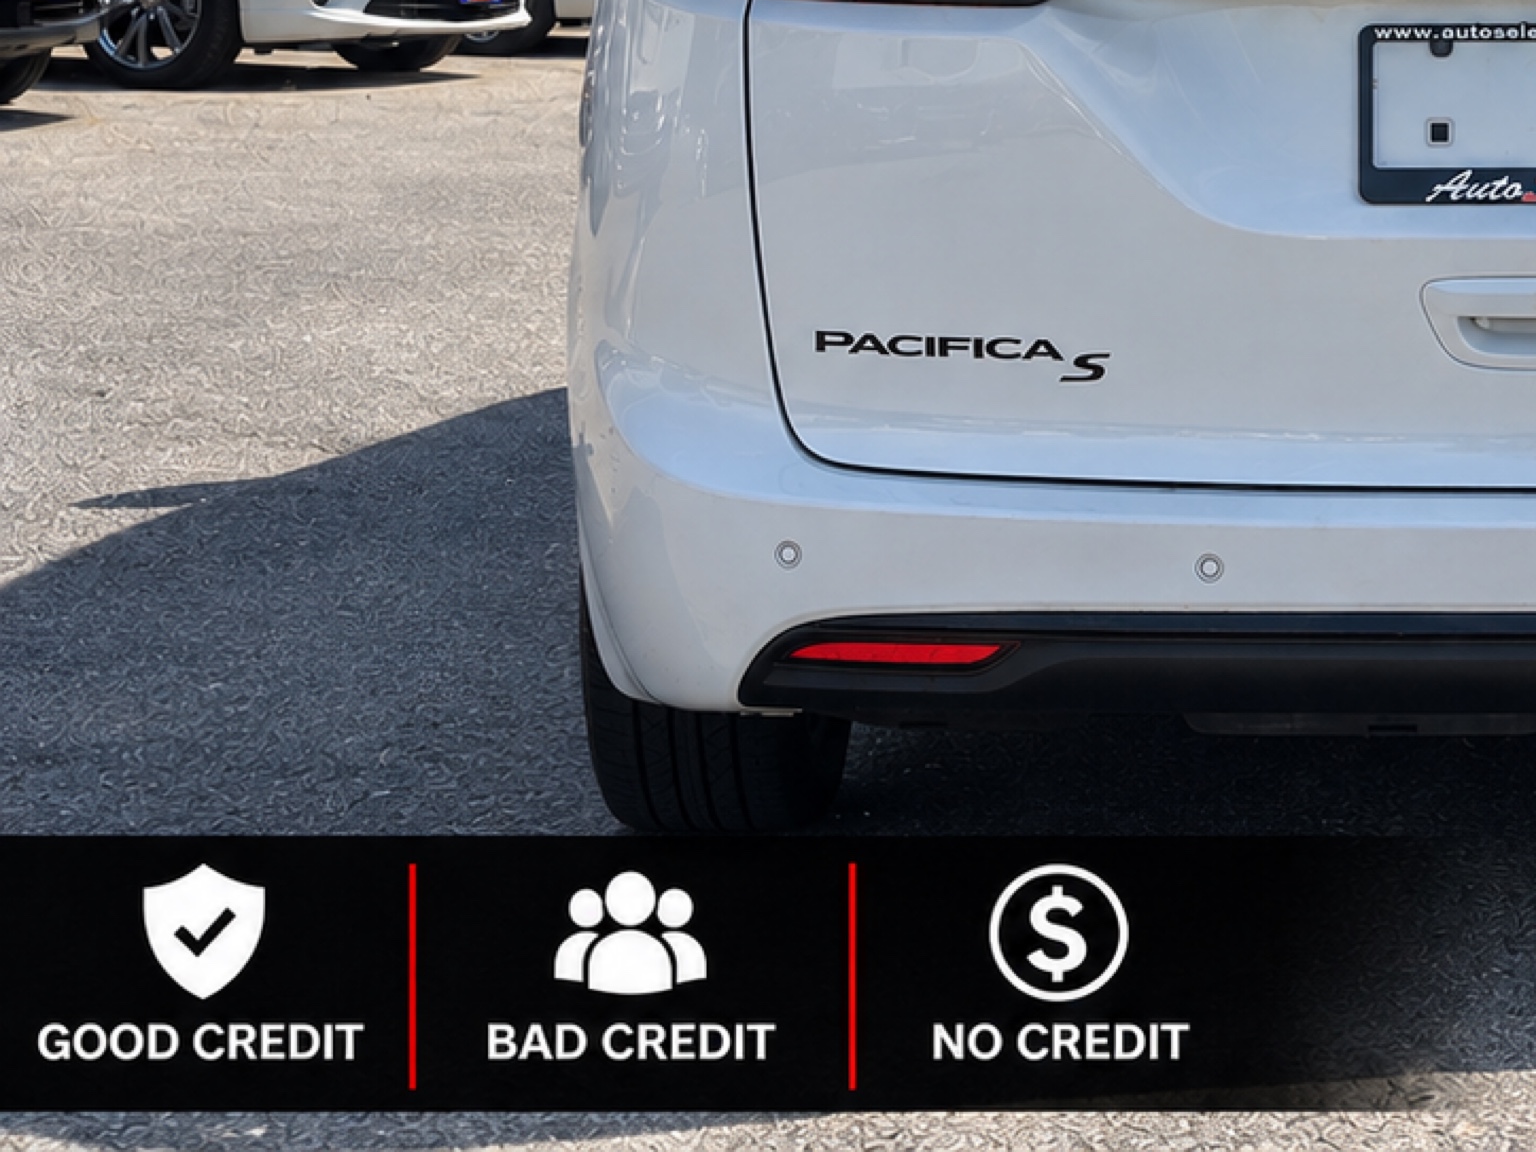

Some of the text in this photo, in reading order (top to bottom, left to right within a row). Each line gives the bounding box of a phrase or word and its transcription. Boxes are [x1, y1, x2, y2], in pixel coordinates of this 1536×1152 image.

[1425, 168, 1525, 202] Auto
[814, 330, 1111, 382] PACIFICA S
